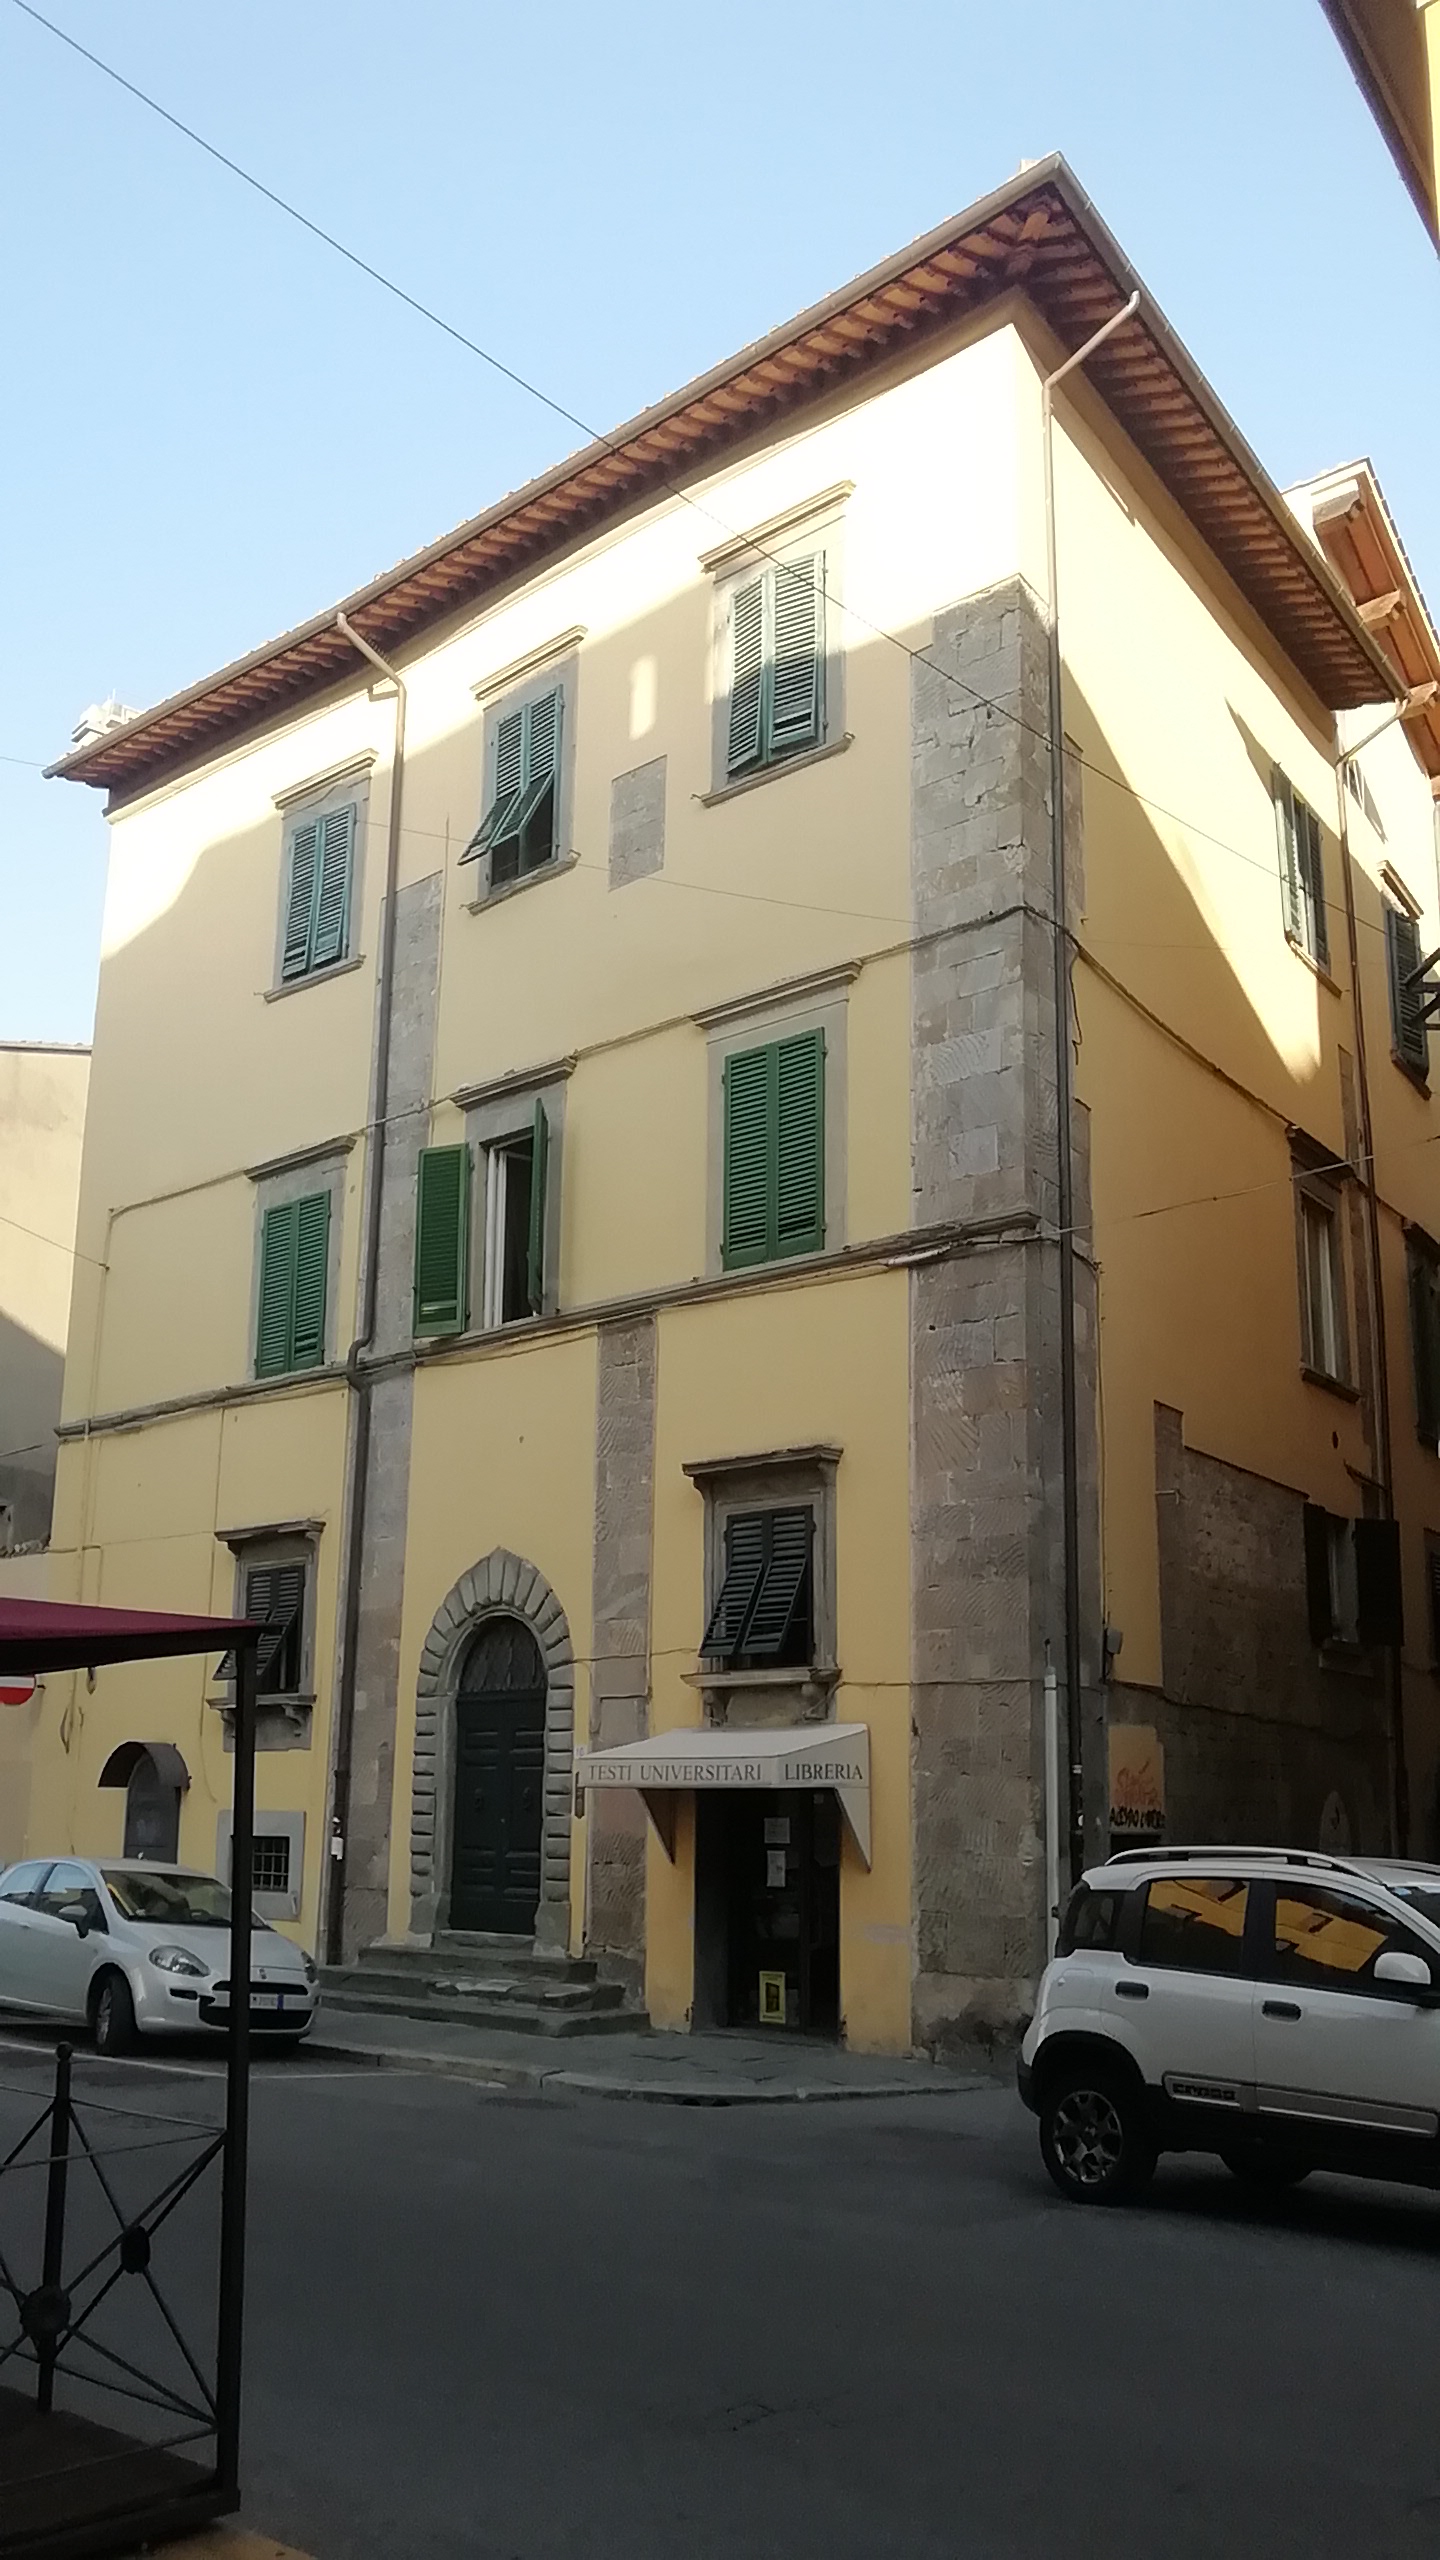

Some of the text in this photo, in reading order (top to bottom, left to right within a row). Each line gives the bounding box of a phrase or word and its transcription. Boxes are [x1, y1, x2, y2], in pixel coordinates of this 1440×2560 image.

[588, 1763, 761, 1782] TESTI UNIVERSITARI
[784, 1762, 863, 1781] LIBRERIA
